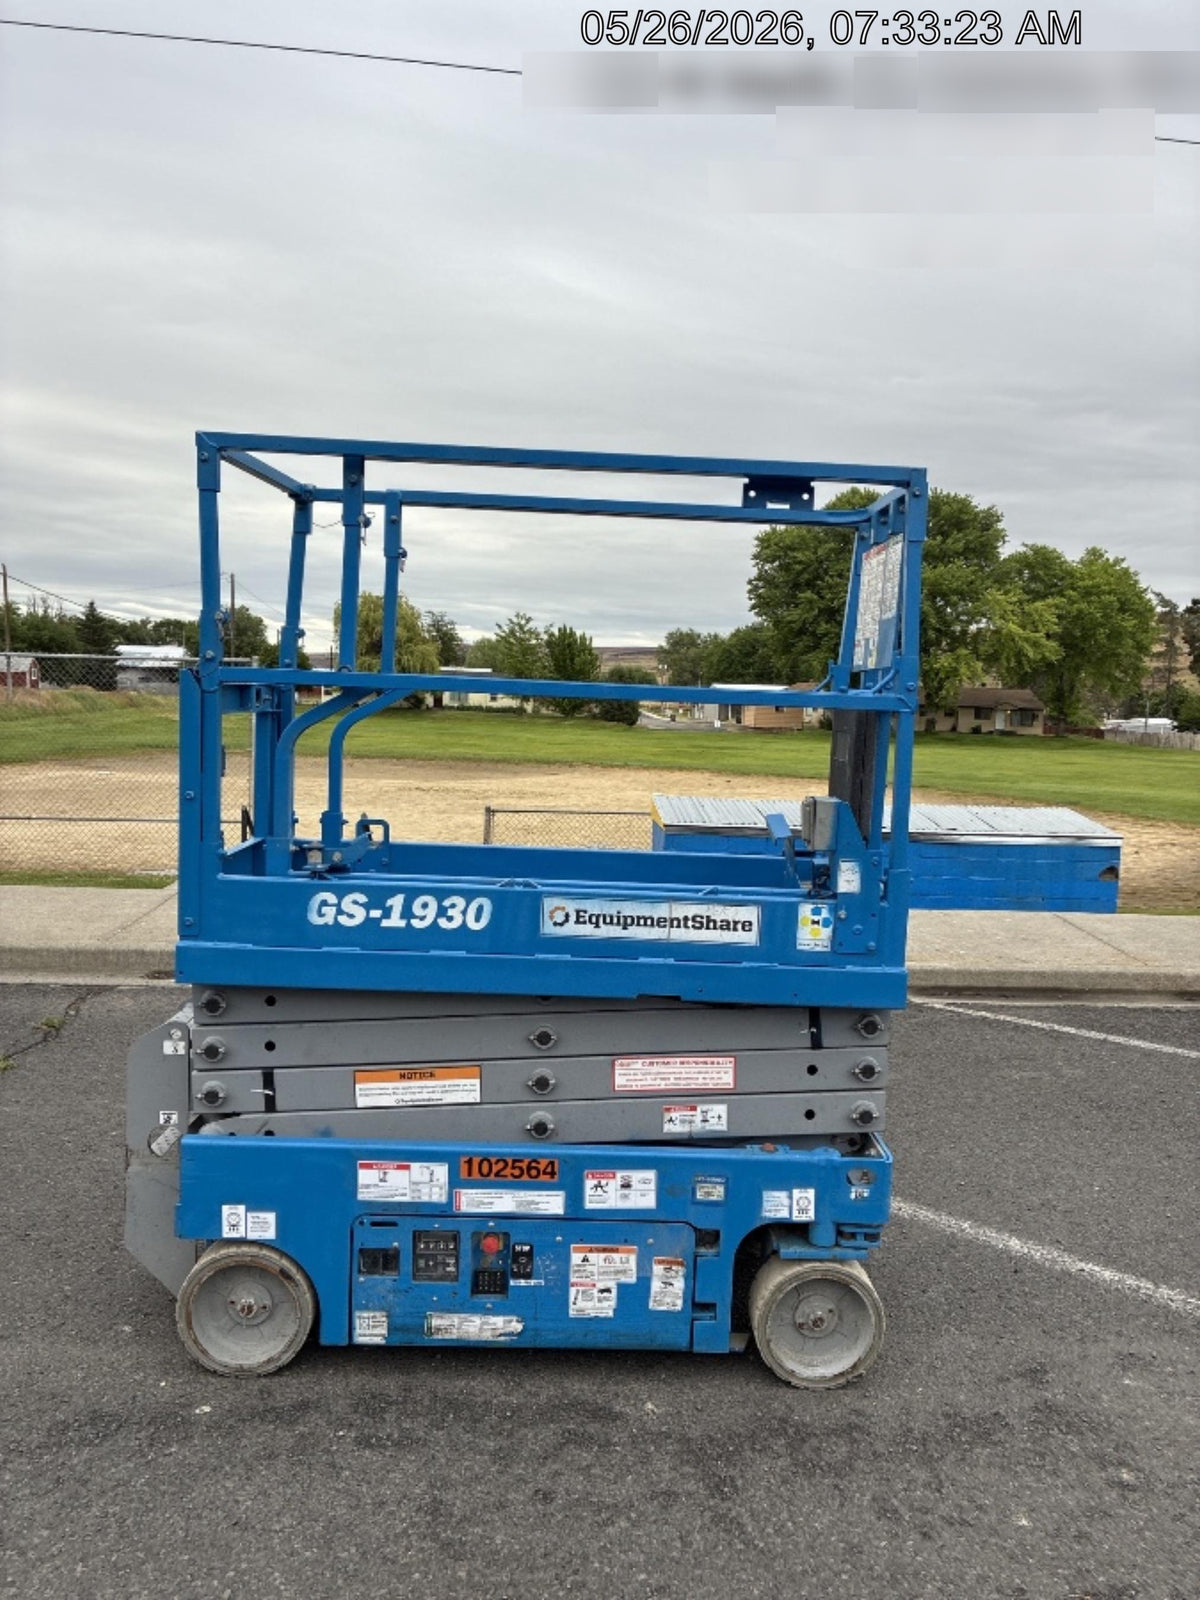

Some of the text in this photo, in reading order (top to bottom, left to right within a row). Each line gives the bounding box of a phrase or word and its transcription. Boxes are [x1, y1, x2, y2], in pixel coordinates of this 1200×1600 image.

[306, 891, 494, 931] GS-1930
[574, 909, 753, 933] EquipmentShare
[463, 1157, 557, 1180] 102564
